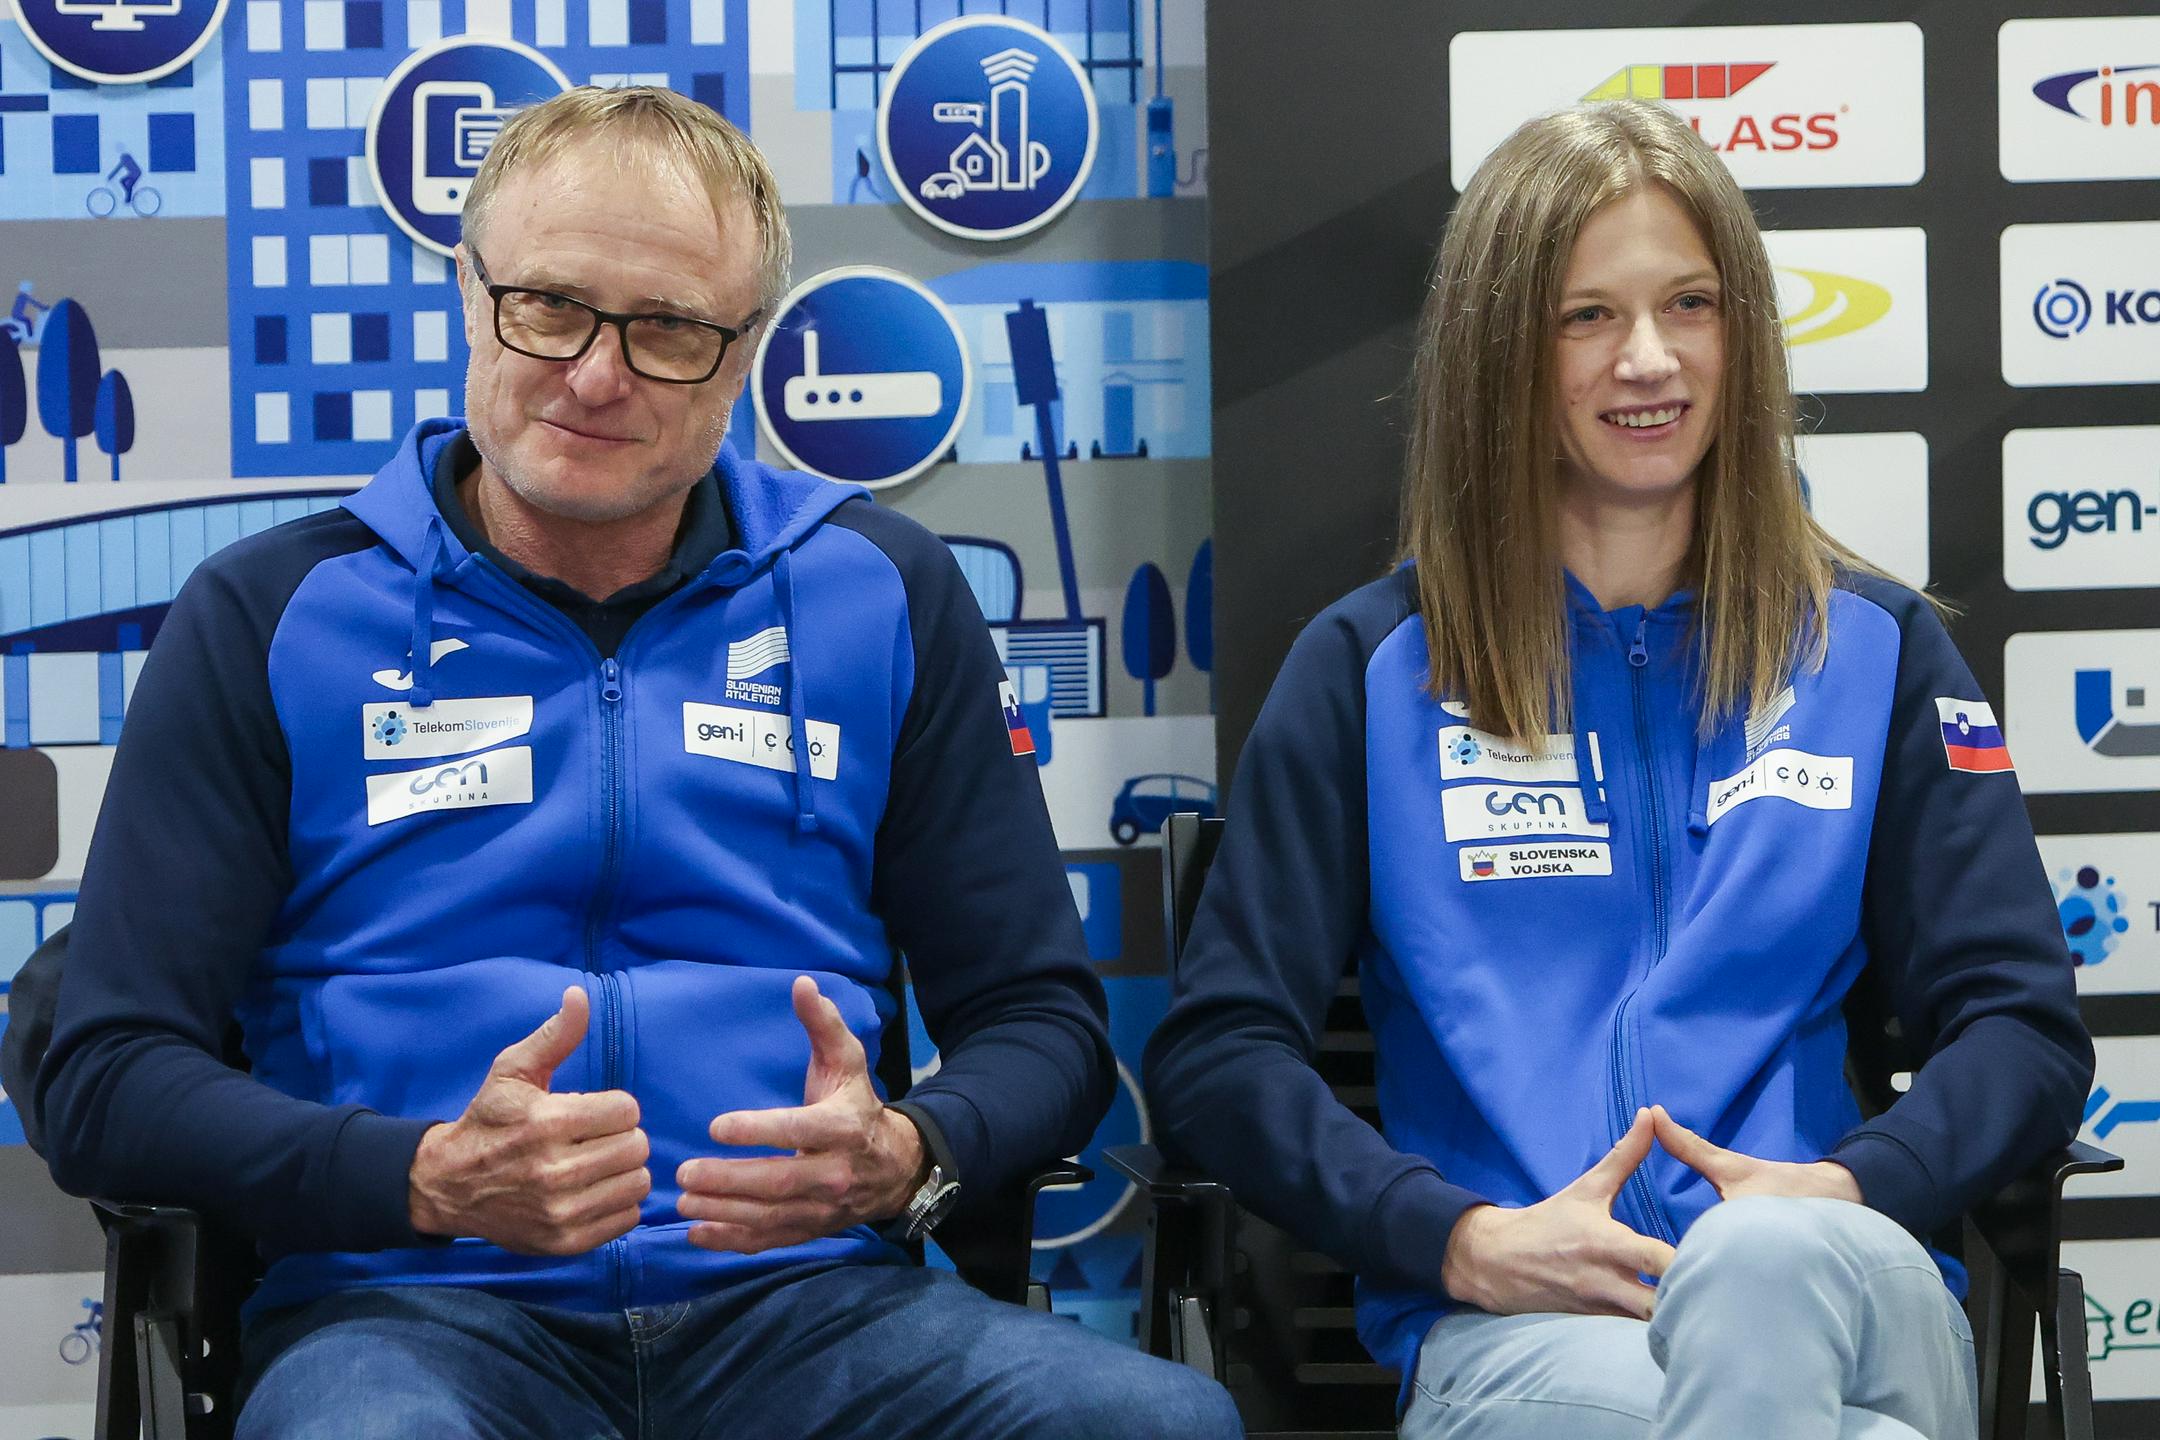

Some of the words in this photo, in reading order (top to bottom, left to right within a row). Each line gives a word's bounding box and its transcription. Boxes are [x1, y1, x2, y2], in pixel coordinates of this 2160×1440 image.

[2028, 490, 2160, 549] gen-
[726, 680, 782, 696] SLOVENIAN
[725, 689, 780, 705] ATHLETICS
[698, 722, 743, 742] gen-i
[1488, 821, 1568, 832] SKUPINA
[1509, 849, 1600, 861] SLOVENSKA
[1511, 863, 1574, 875] VOJSKA
